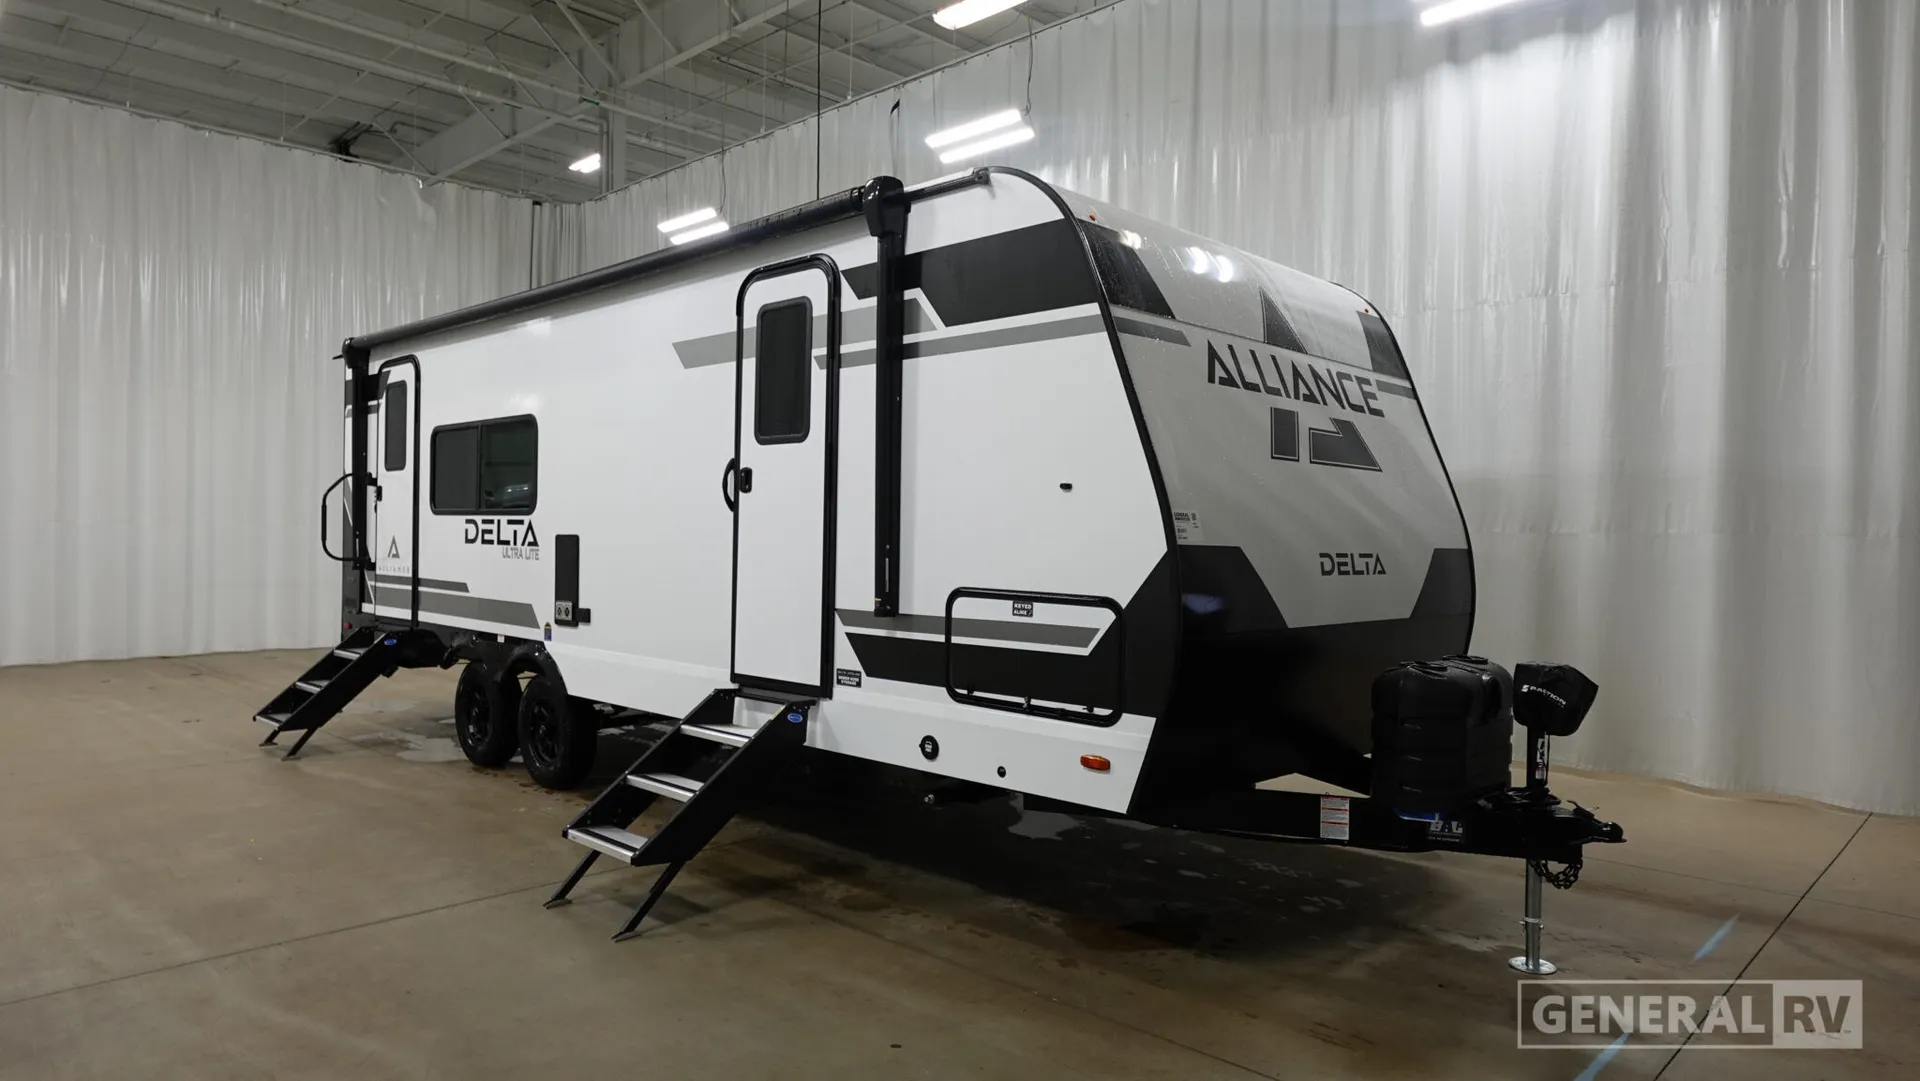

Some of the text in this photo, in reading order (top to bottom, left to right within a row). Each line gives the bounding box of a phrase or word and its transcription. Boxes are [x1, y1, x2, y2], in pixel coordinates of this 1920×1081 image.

[1207, 339, 1385, 418] ALLIANCE
[464, 518, 540, 547] DELTA
[501, 546, 540, 561] ULTRA LITE
[1318, 552, 1387, 576] DELTA
